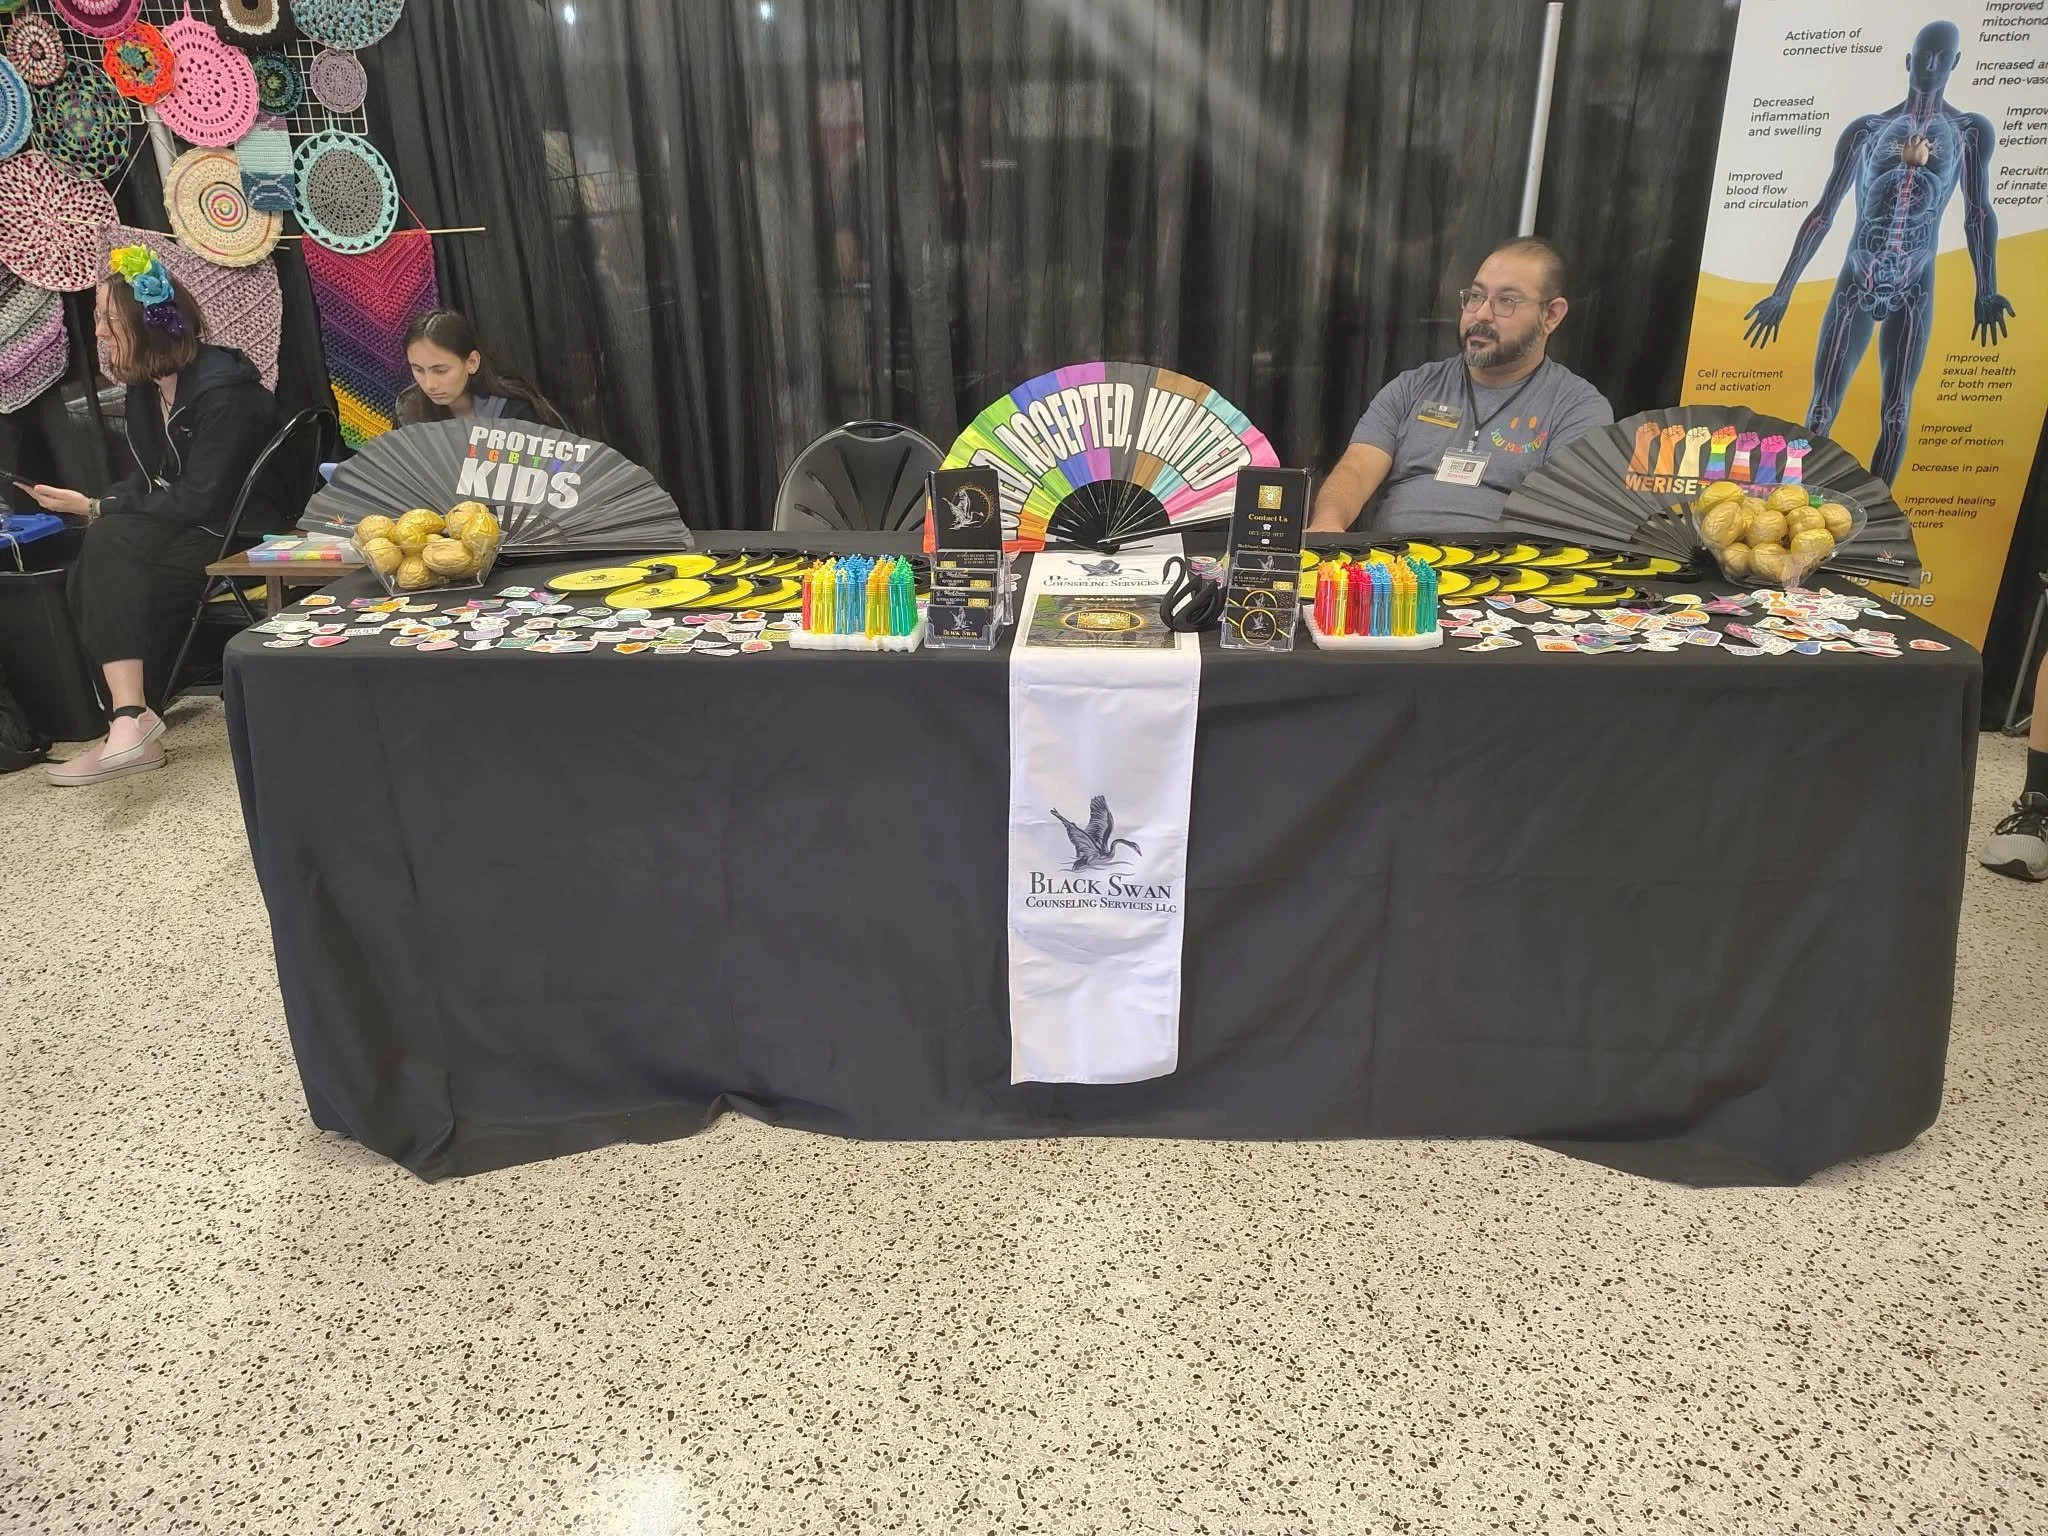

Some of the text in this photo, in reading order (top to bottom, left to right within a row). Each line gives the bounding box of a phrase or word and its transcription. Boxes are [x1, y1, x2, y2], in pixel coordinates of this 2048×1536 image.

[1986, 0, 2044, 13] Improved
[1785, 28, 1862, 41] Activation of
[1979, 31, 2030, 42] function
[1782, 43, 1883, 56] connective tissue
[1976, 59, 2035, 70] Increased
[1972, 75, 1995, 86] and
[1753, 96, 1815, 108] Decreased
[1750, 110, 1830, 122] inflammation
[1748, 125, 1822, 138] and swelling
[2003, 121, 2023, 130] left
[1999, 135, 2047, 147] ejection
[1728, 170, 1783, 183] Improved
[1726, 184, 1788, 196] blood flow
[1996, 180, 2047, 190] of innate
[1723, 198, 1809, 210] and circulation
[1993, 195, 2043, 207] receptor
[1946, 353, 1999, 365] Improved
[1698, 369, 1783, 379] Cell recruitment
[1942, 366, 2016, 376] sexual health
[1696, 381, 1771, 392] and activation
[1940, 379, 2013, 389] for both men
[1936, 391, 2003, 402] and women
[1920, 423, 1972, 435] Improved
[992, 383, 1135, 477] ACCEPTED,
[1136, 387, 1252, 491] WANTED
[1918, 436, 2004, 448] range of motion
[468, 425, 591, 463] PROTECT
[1911, 463, 1999, 475] Decrease in pain
[455, 457, 581, 509] KIDS
[1904, 495, 1996, 507] Improved healing
[1903, 507, 1977, 518] of non-healing
[1890, 590, 1935, 607] time
[1029, 871, 1172, 899] BLACK SWAN
[1025, 896, 1177, 914] COUNSELING SERVICES LLC
